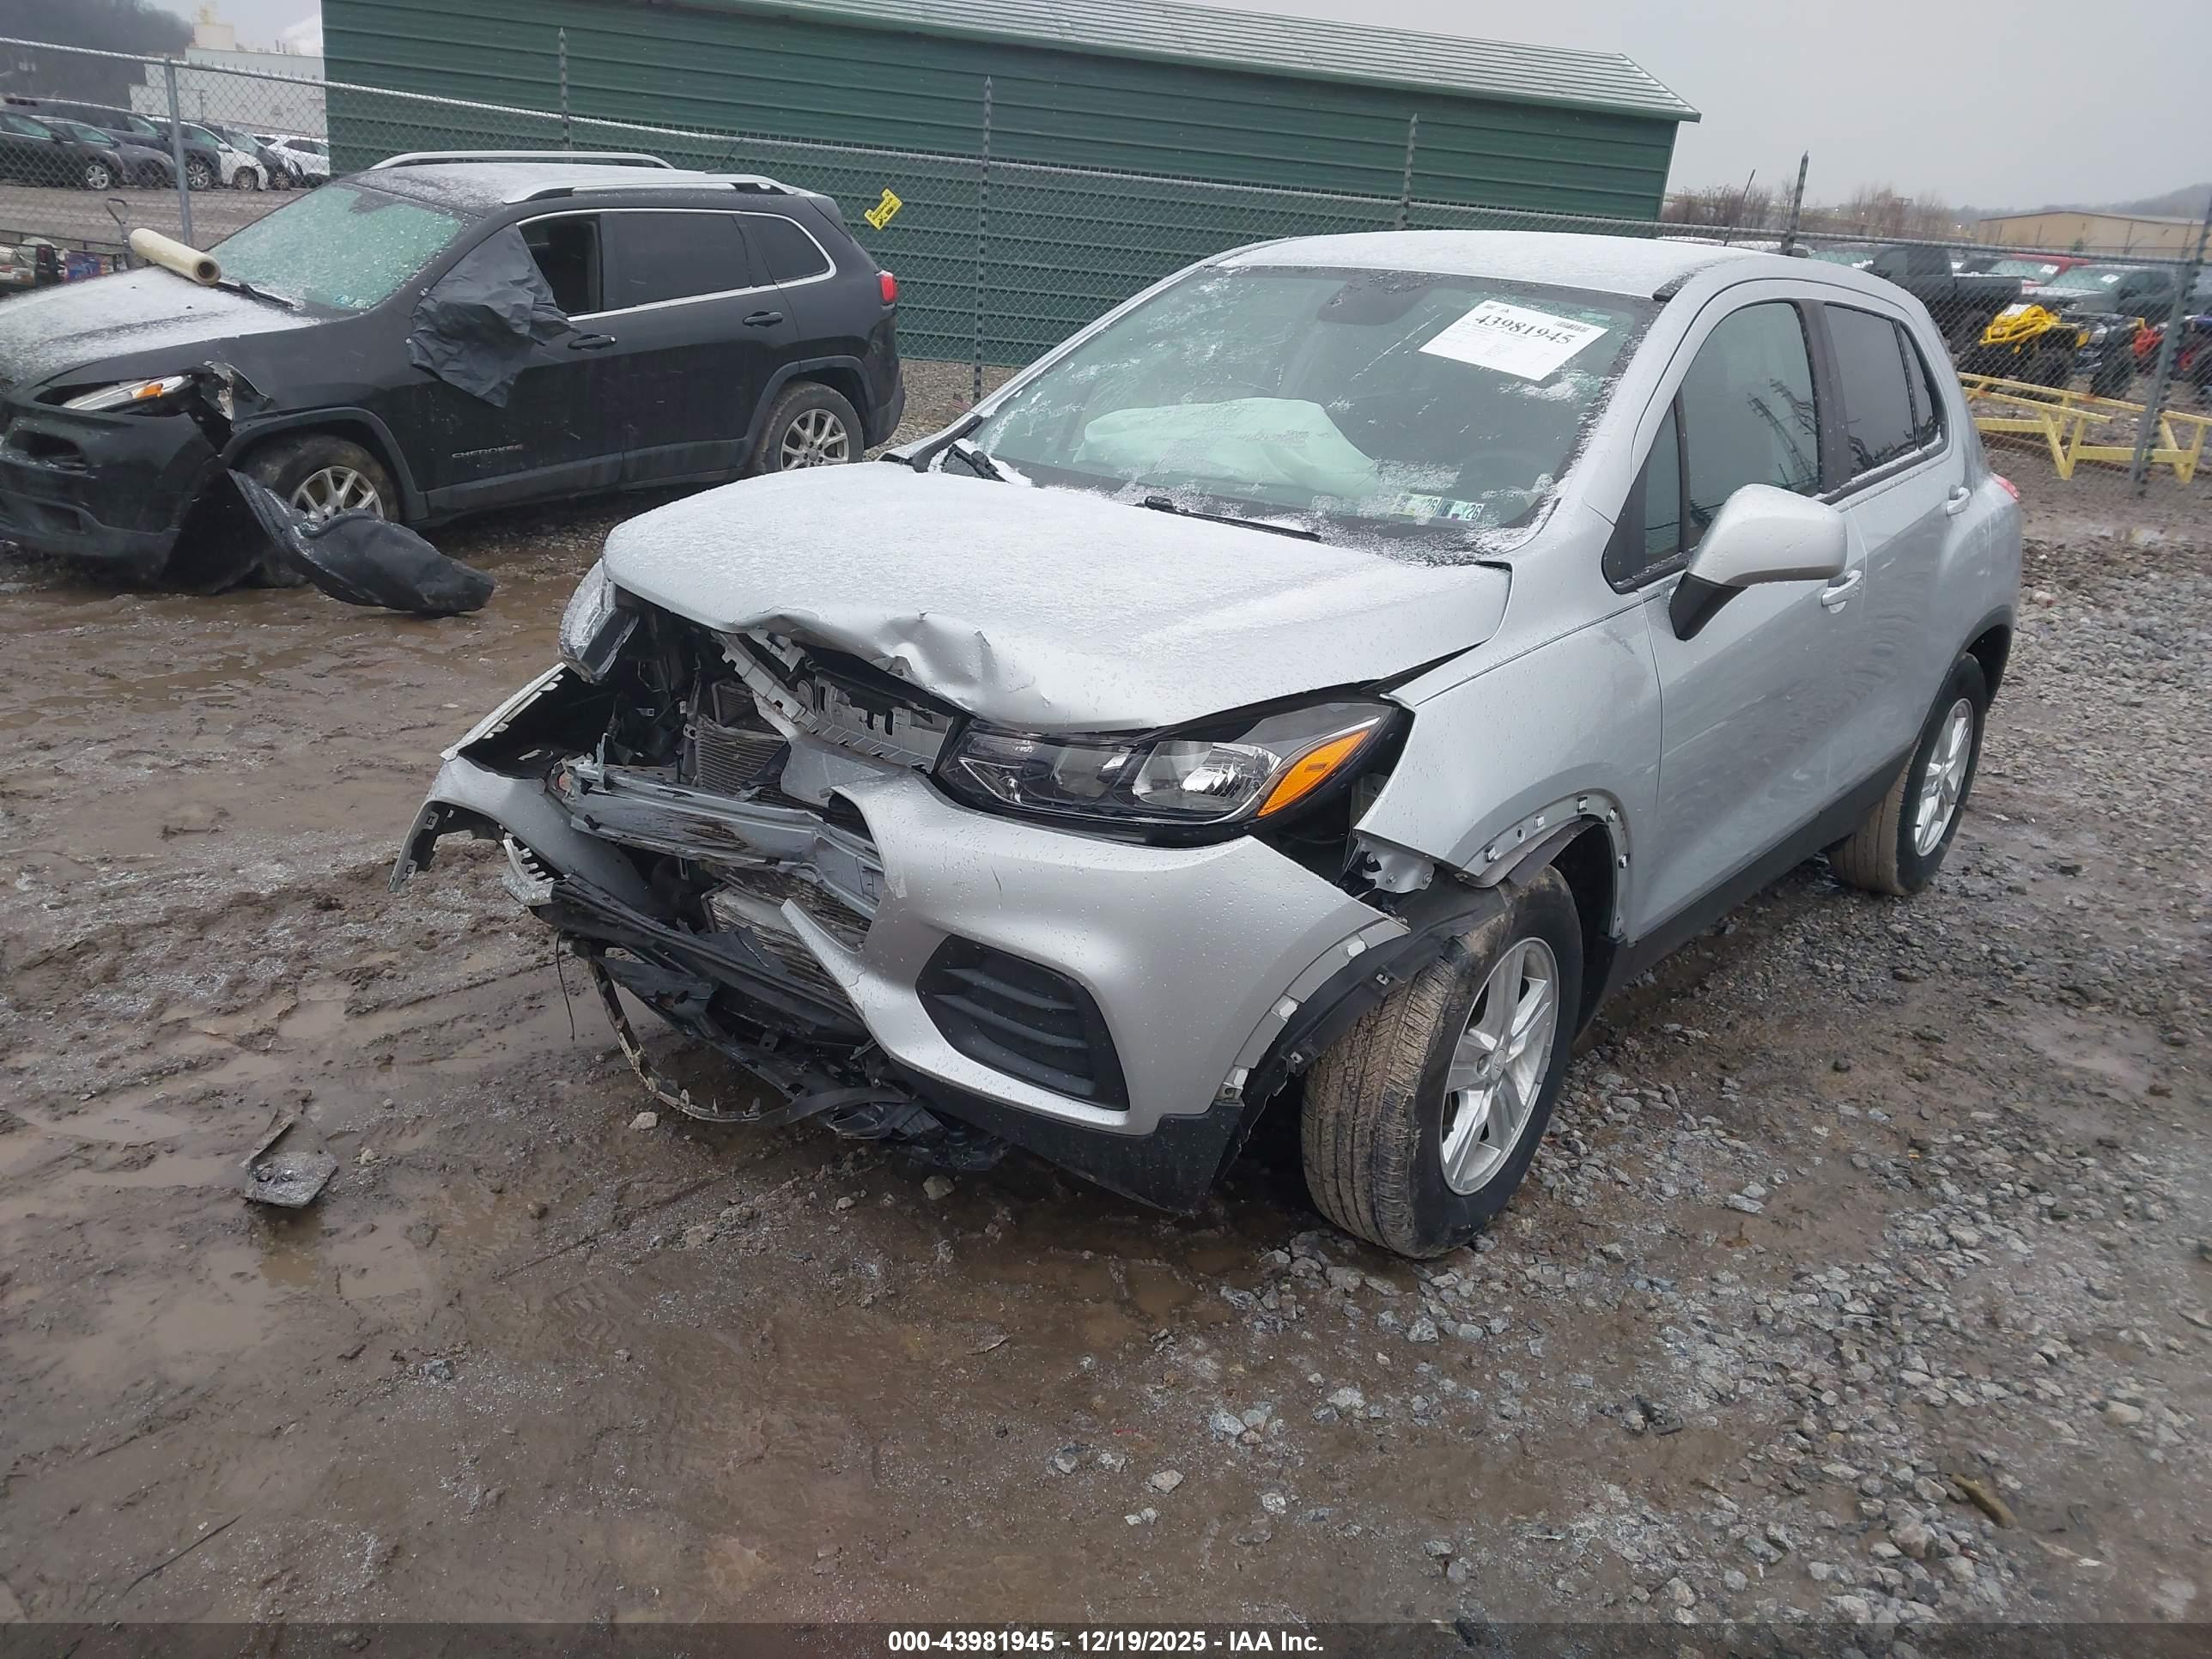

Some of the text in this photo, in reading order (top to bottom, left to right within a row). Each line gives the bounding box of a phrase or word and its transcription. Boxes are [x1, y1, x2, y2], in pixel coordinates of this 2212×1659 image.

[1474, 313, 1577, 345] 43981945
[451, 443, 523, 459] CHEROKEE
[1465, 503, 1482, 520] 26
